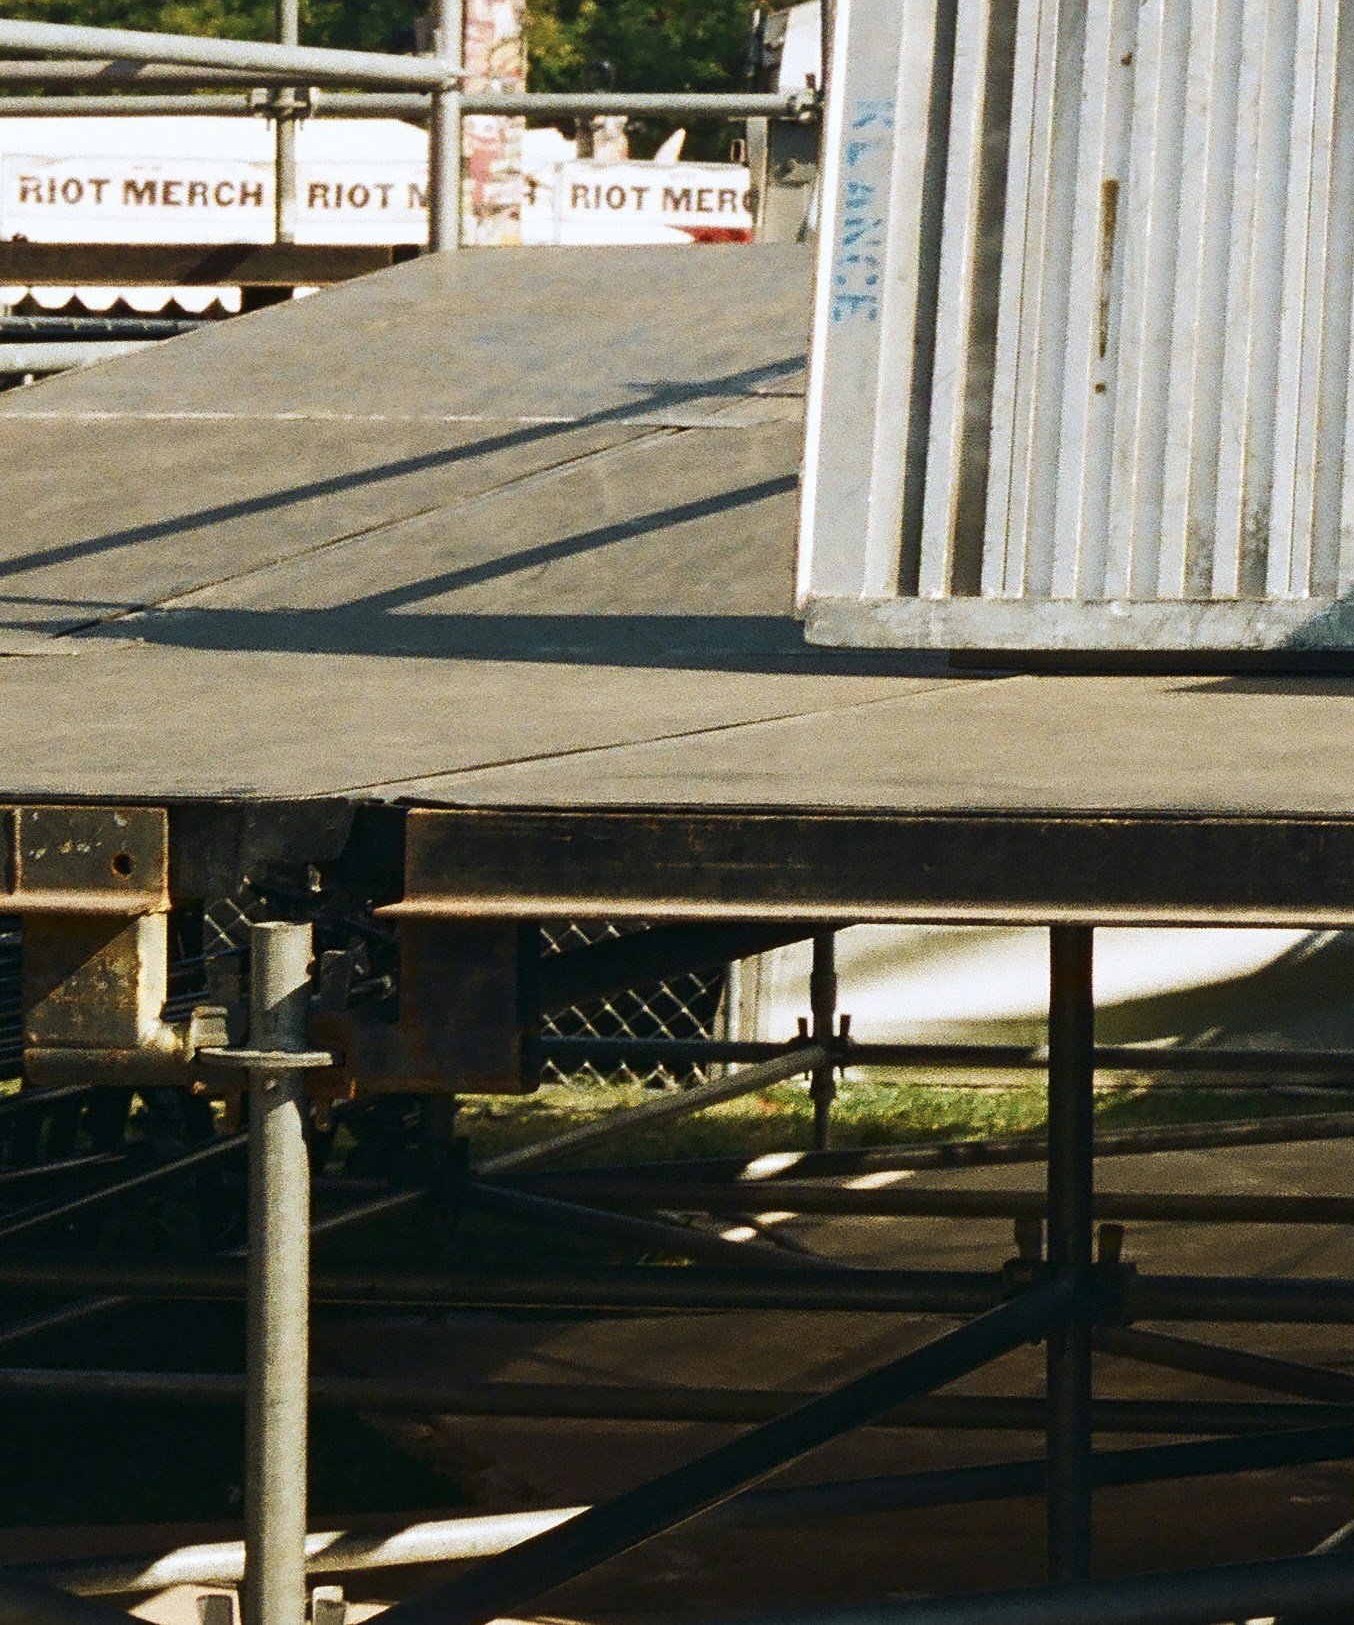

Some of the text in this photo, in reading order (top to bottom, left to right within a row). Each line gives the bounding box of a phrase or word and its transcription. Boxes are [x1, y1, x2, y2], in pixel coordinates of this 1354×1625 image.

[18, 174, 263, 208] RIOT MERCH
[307, 182, 394, 210] RIOT
[570, 183, 650, 211] RIOT
